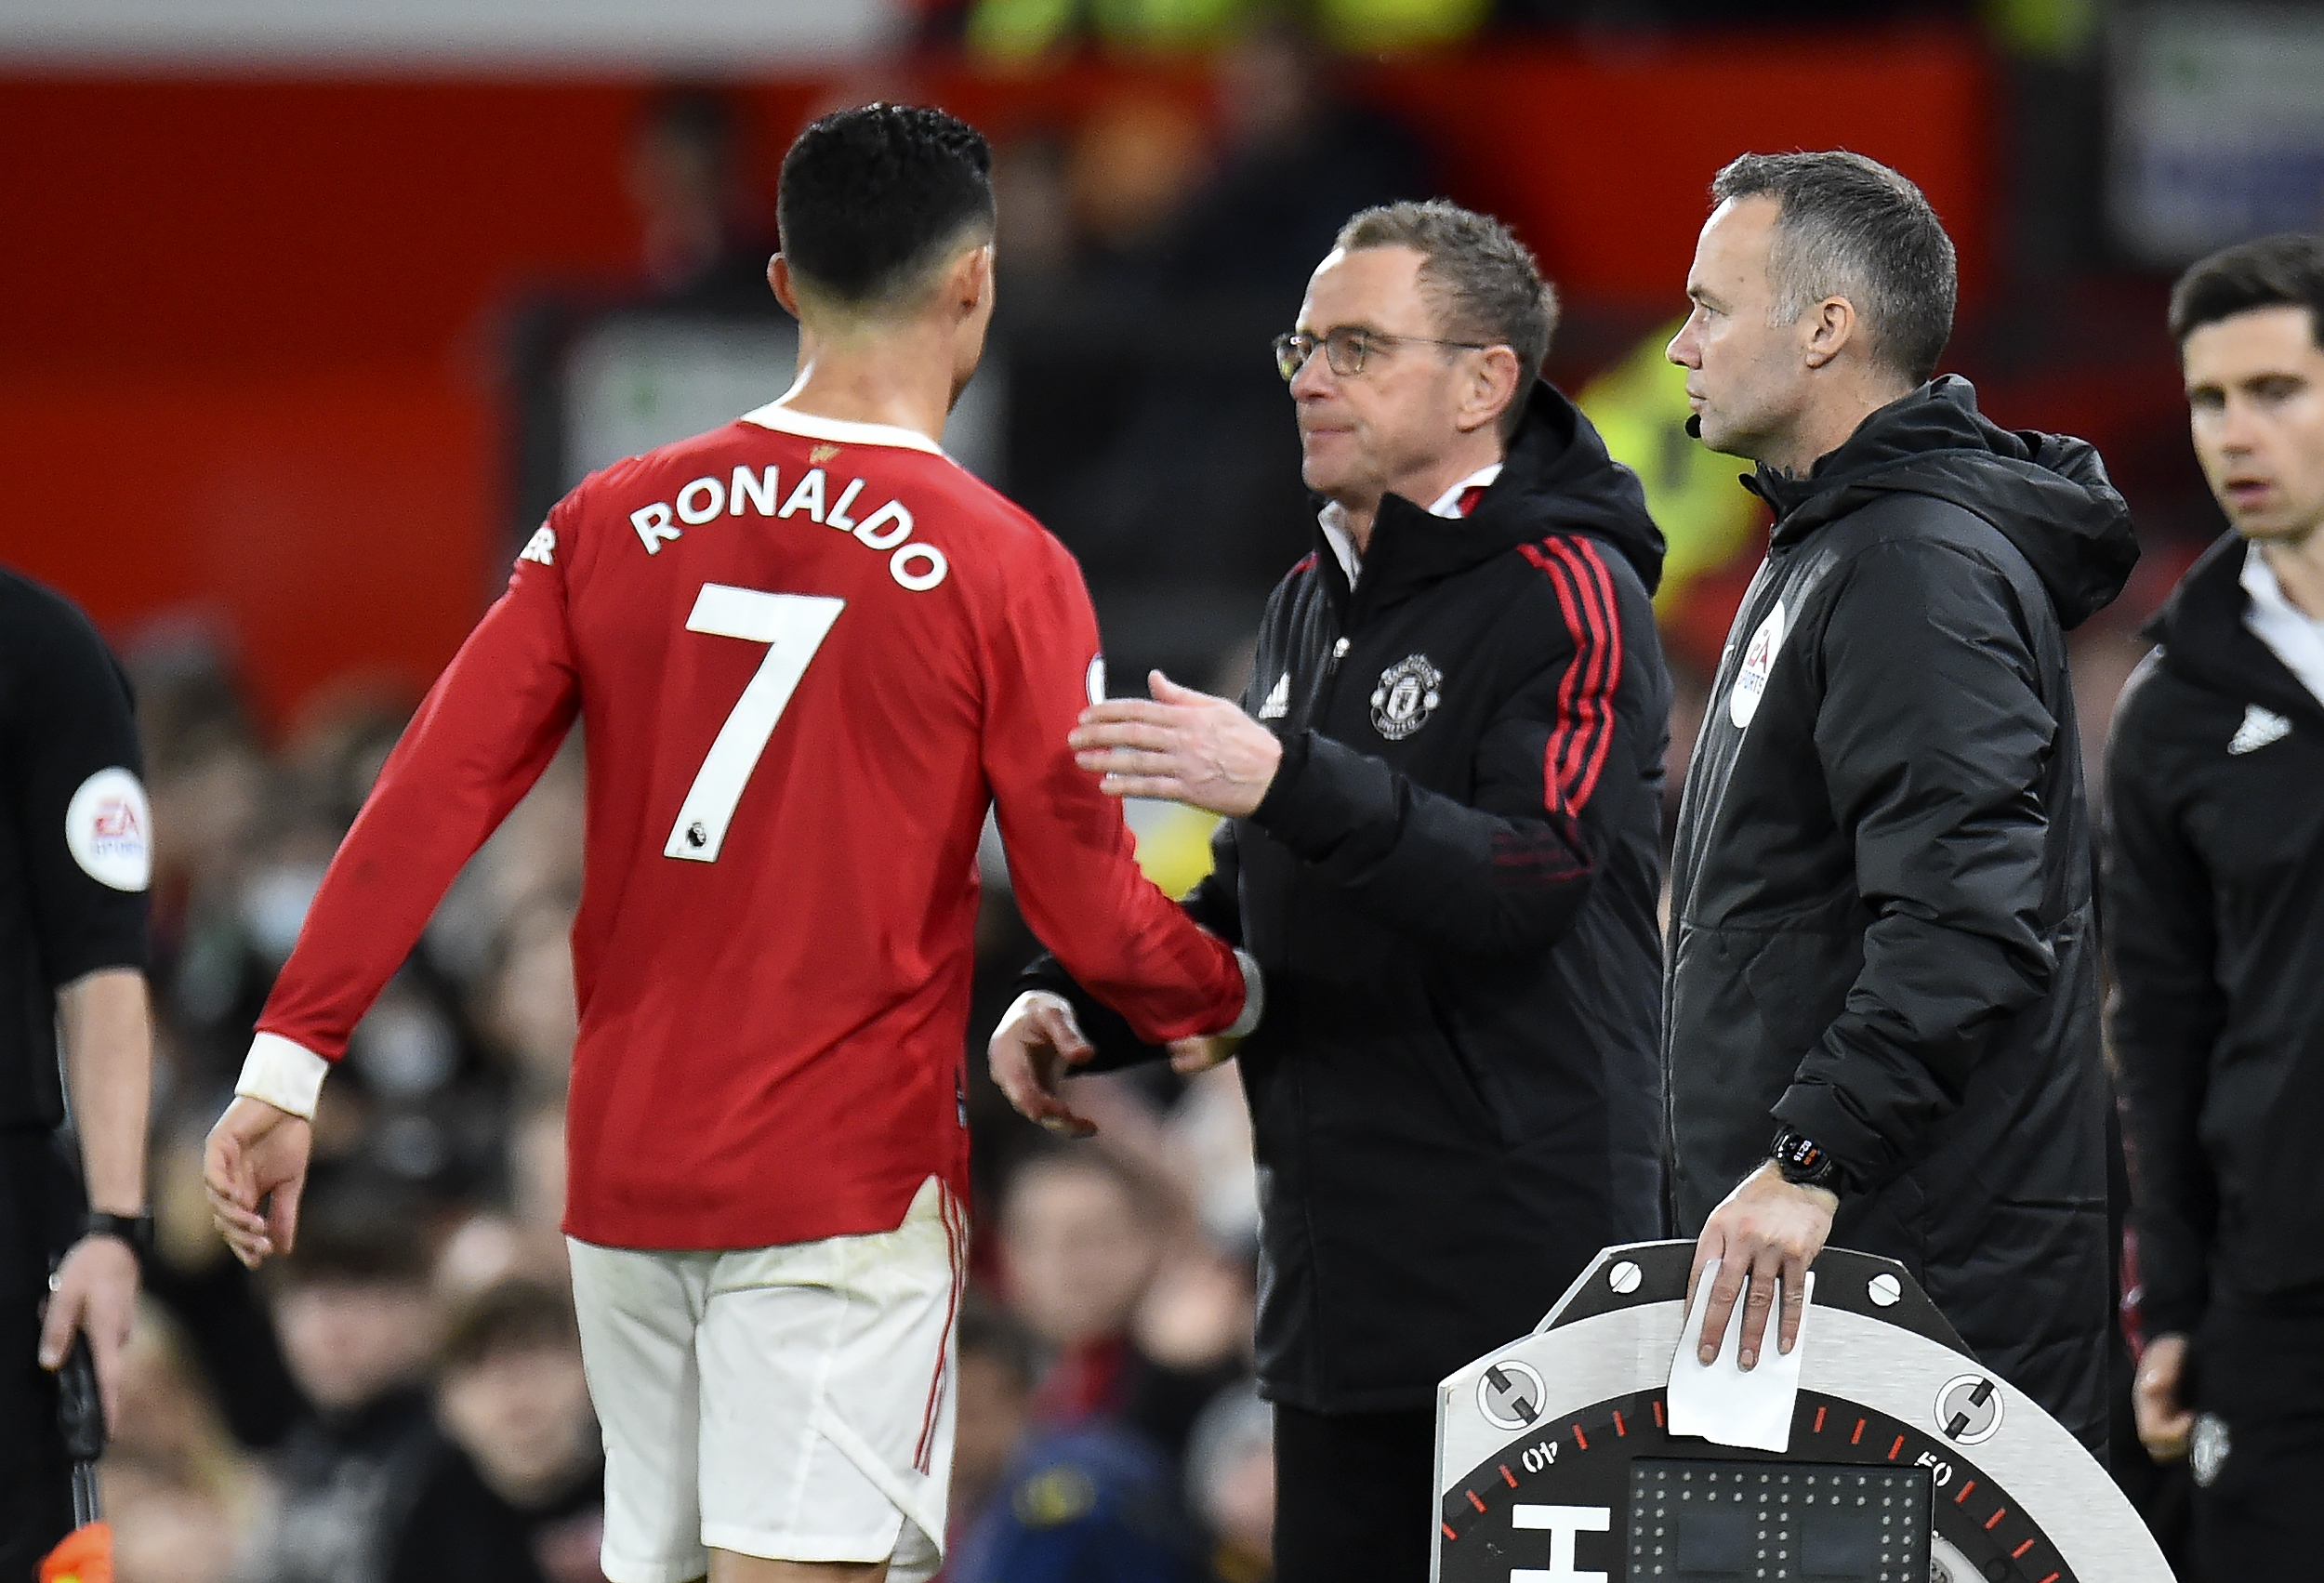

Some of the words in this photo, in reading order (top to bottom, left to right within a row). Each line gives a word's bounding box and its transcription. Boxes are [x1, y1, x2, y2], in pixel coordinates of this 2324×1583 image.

[630, 464, 949, 592] RONALDO
[664, 583, 846, 863] 7
[1522, 1440, 1559, 1473] 40
